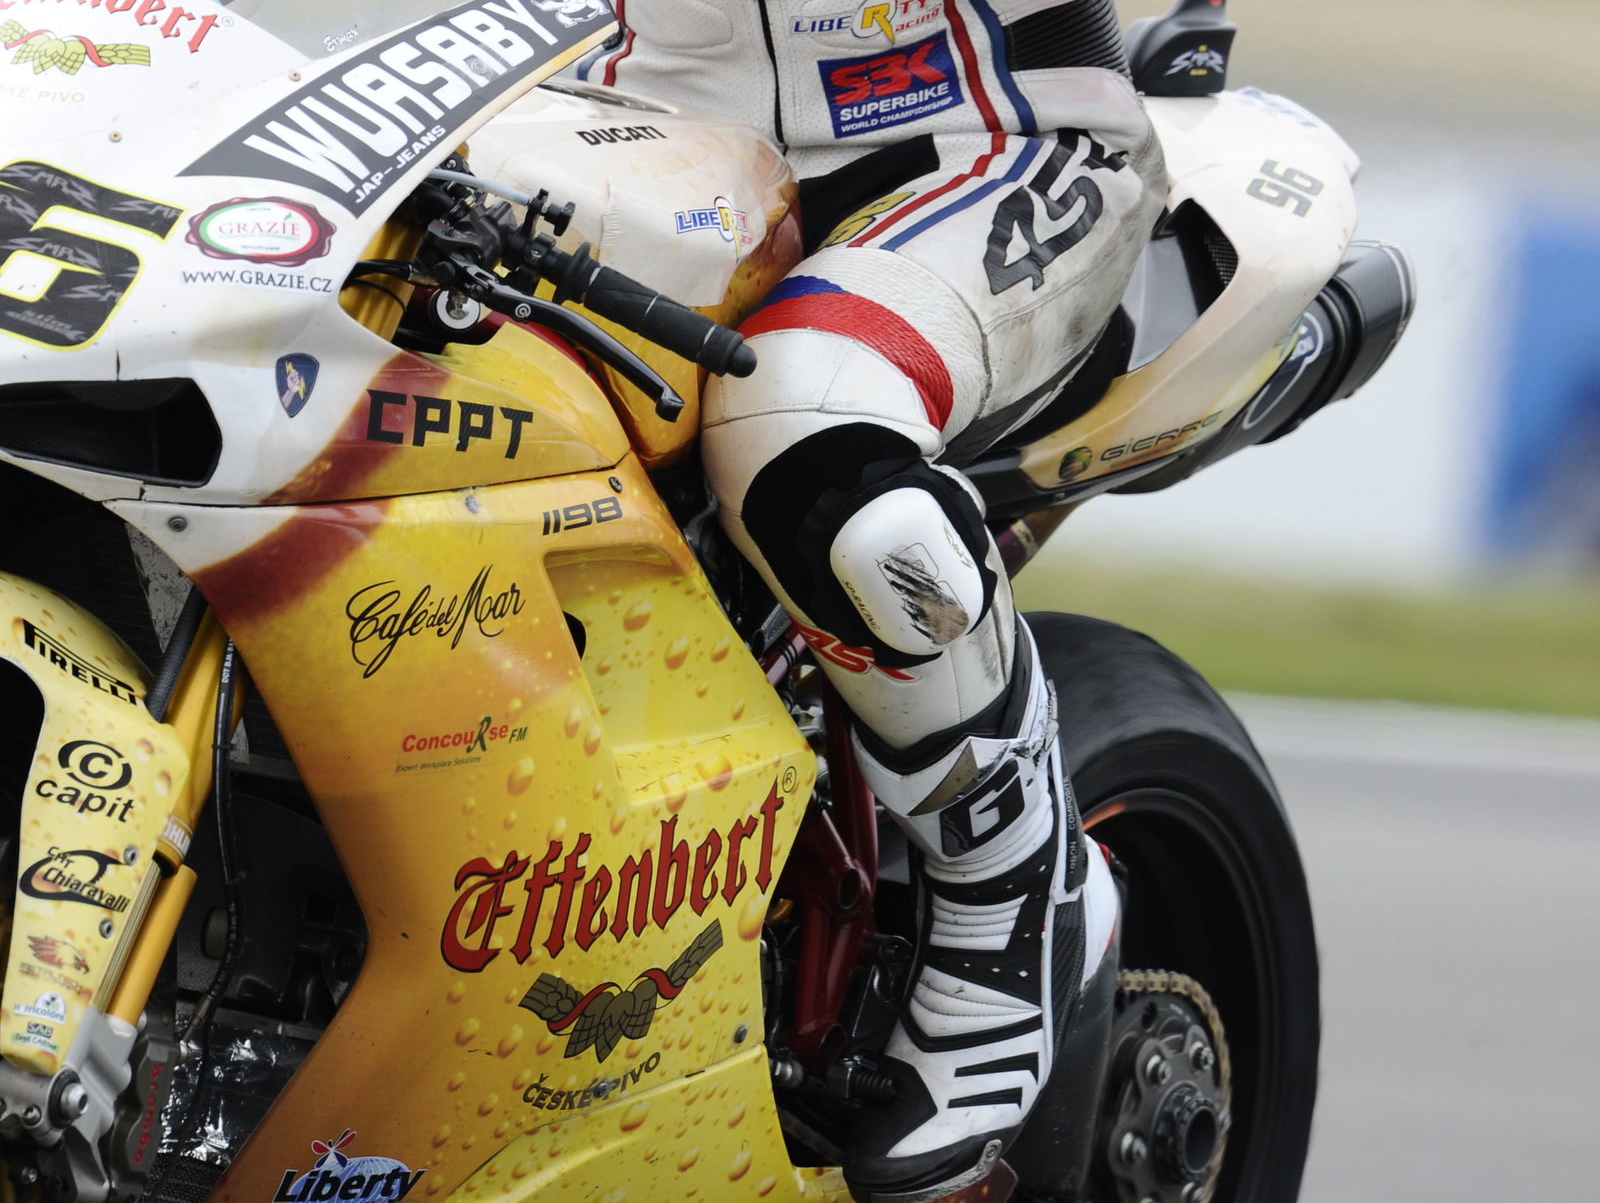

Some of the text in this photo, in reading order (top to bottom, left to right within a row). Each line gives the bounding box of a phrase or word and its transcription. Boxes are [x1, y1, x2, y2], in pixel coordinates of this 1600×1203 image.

[829, 41, 948, 106] SBK
[839, 81, 950, 122] SUPERBIKE
[840, 96, 954, 133] WORLD CHAMPIONSHIP
[574, 125, 669, 146] DUCATI
[218, 213, 300, 237] GRAZIE
[182, 269, 332, 294] WWW.GRAZIE.CZ
[366, 389, 534, 460] CPPT
[542, 496, 624, 537] 1198
[345, 563, 527, 679] Café del Mar
[22, 618, 138, 707] PIRELLI
[508, 726, 529, 744] FM
[35, 779, 136, 824] capit
[43, 866, 132, 914] Chiaravalli
[440, 774, 784, 974] Effenbert
[133, 1062, 165, 1165] brembo
[273, 1168, 431, 1203] Liberty
